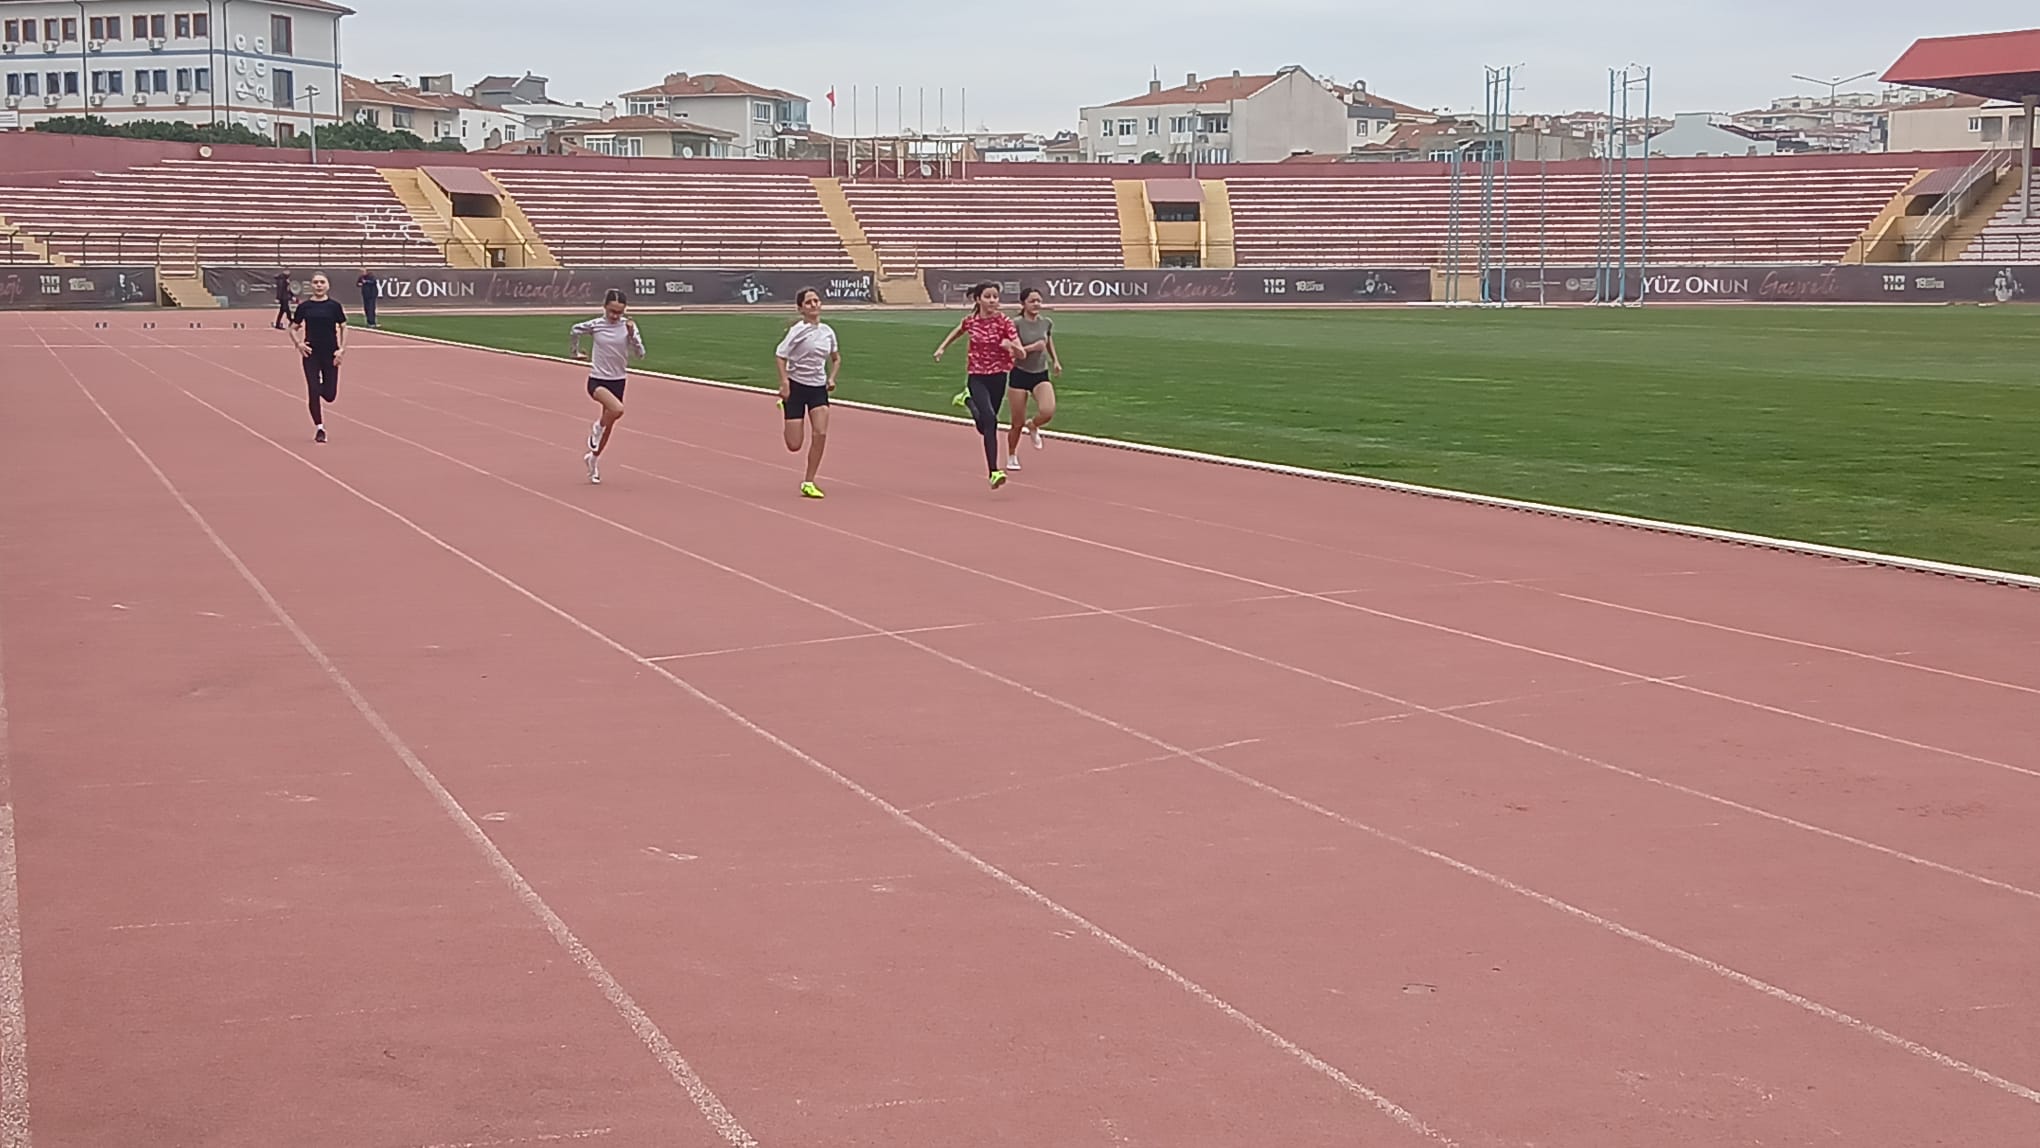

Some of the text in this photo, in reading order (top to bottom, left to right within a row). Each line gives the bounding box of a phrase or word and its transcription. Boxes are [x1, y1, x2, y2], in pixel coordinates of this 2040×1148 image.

[376, 278, 412, 297] YÜZ
[416, 278, 474, 297] ONUN
[634, 278, 656, 294] 110
[1046, 271, 1236, 298] YÜZ ONUN Cesareti
[1263, 279, 1286, 293] 110
[1643, 275, 1681, 293] YÜZ
[1685, 276, 1748, 294] ONUN
[1882, 275, 1905, 291] 110
